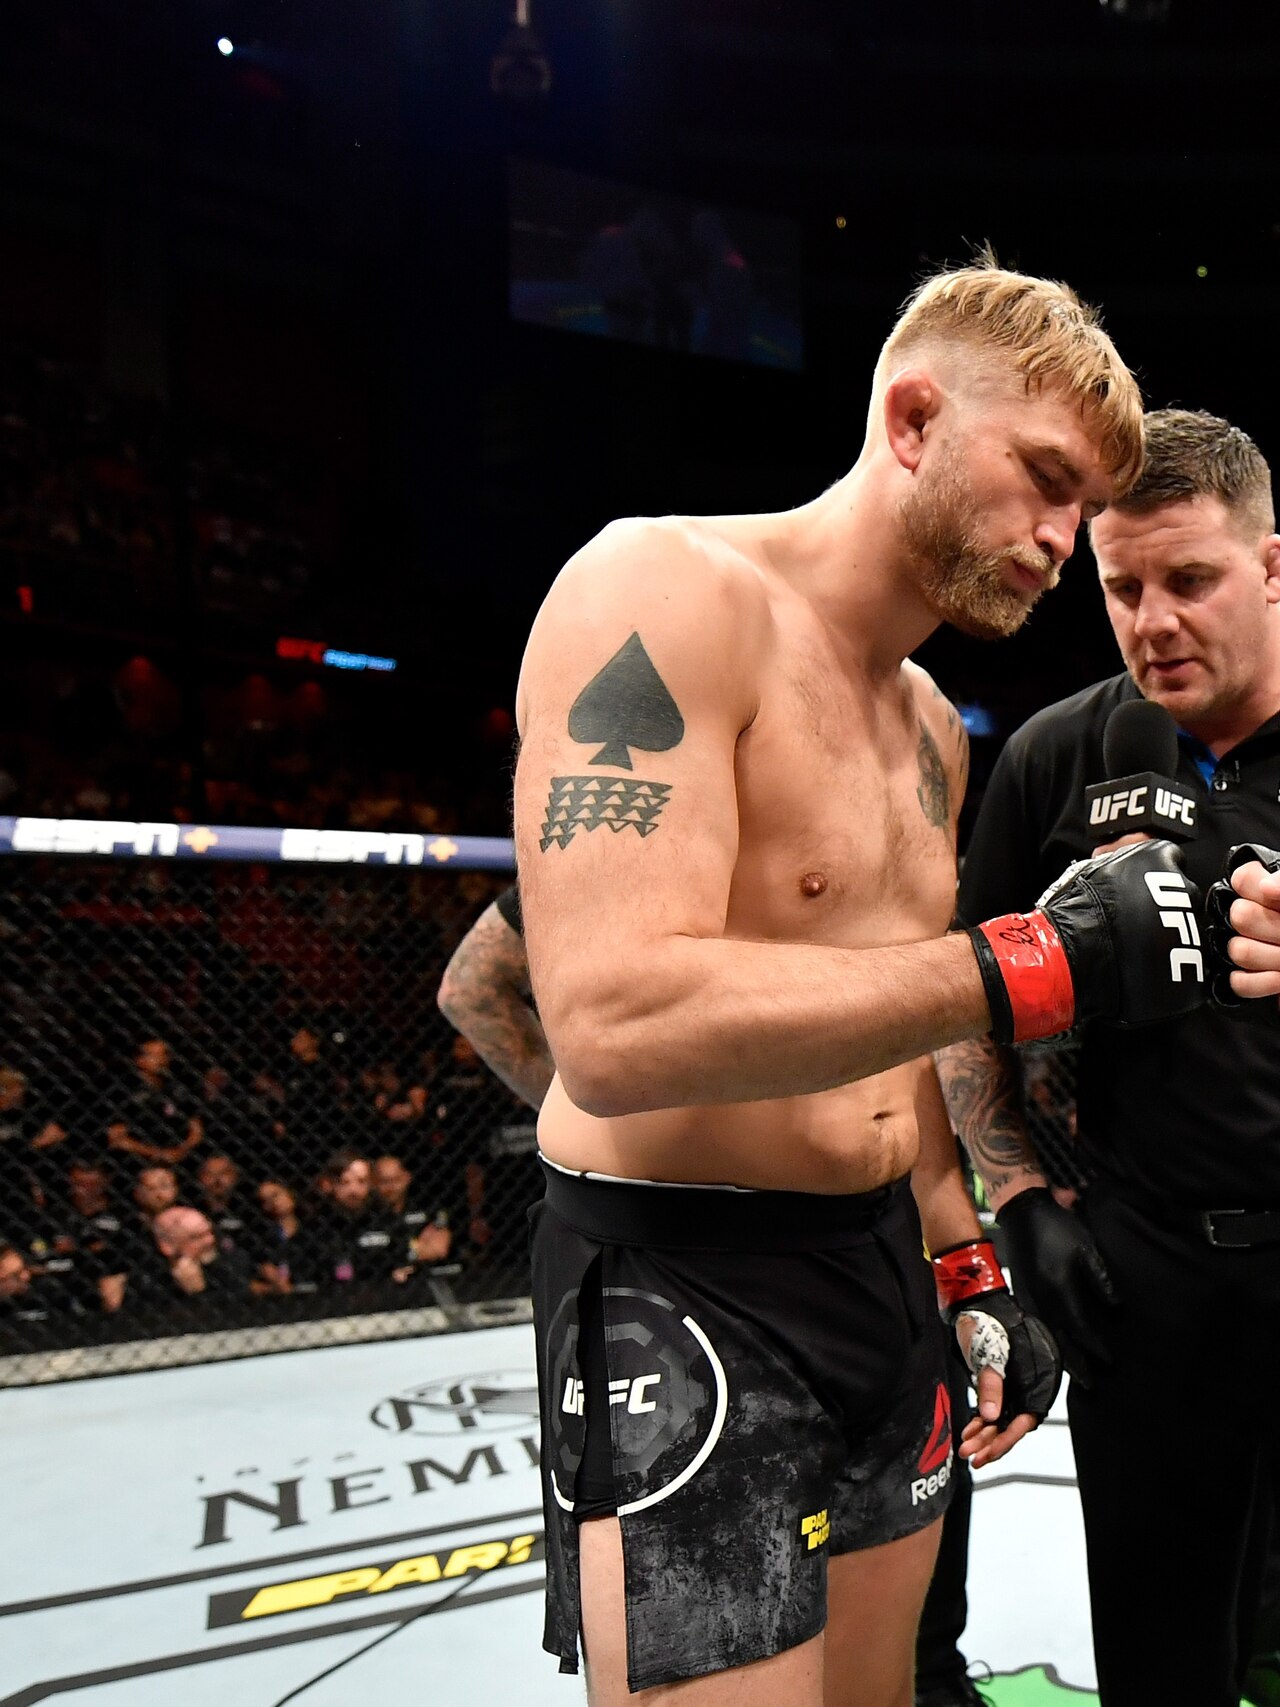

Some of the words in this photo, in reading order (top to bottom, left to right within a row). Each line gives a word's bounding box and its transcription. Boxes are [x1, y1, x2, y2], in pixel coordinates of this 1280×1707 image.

[1090, 787, 1148, 825] UFC
[1154, 788, 1196, 826] UFC
[1144, 871, 1204, 982] UFC
[911, 1447, 953, 1506] Ree
